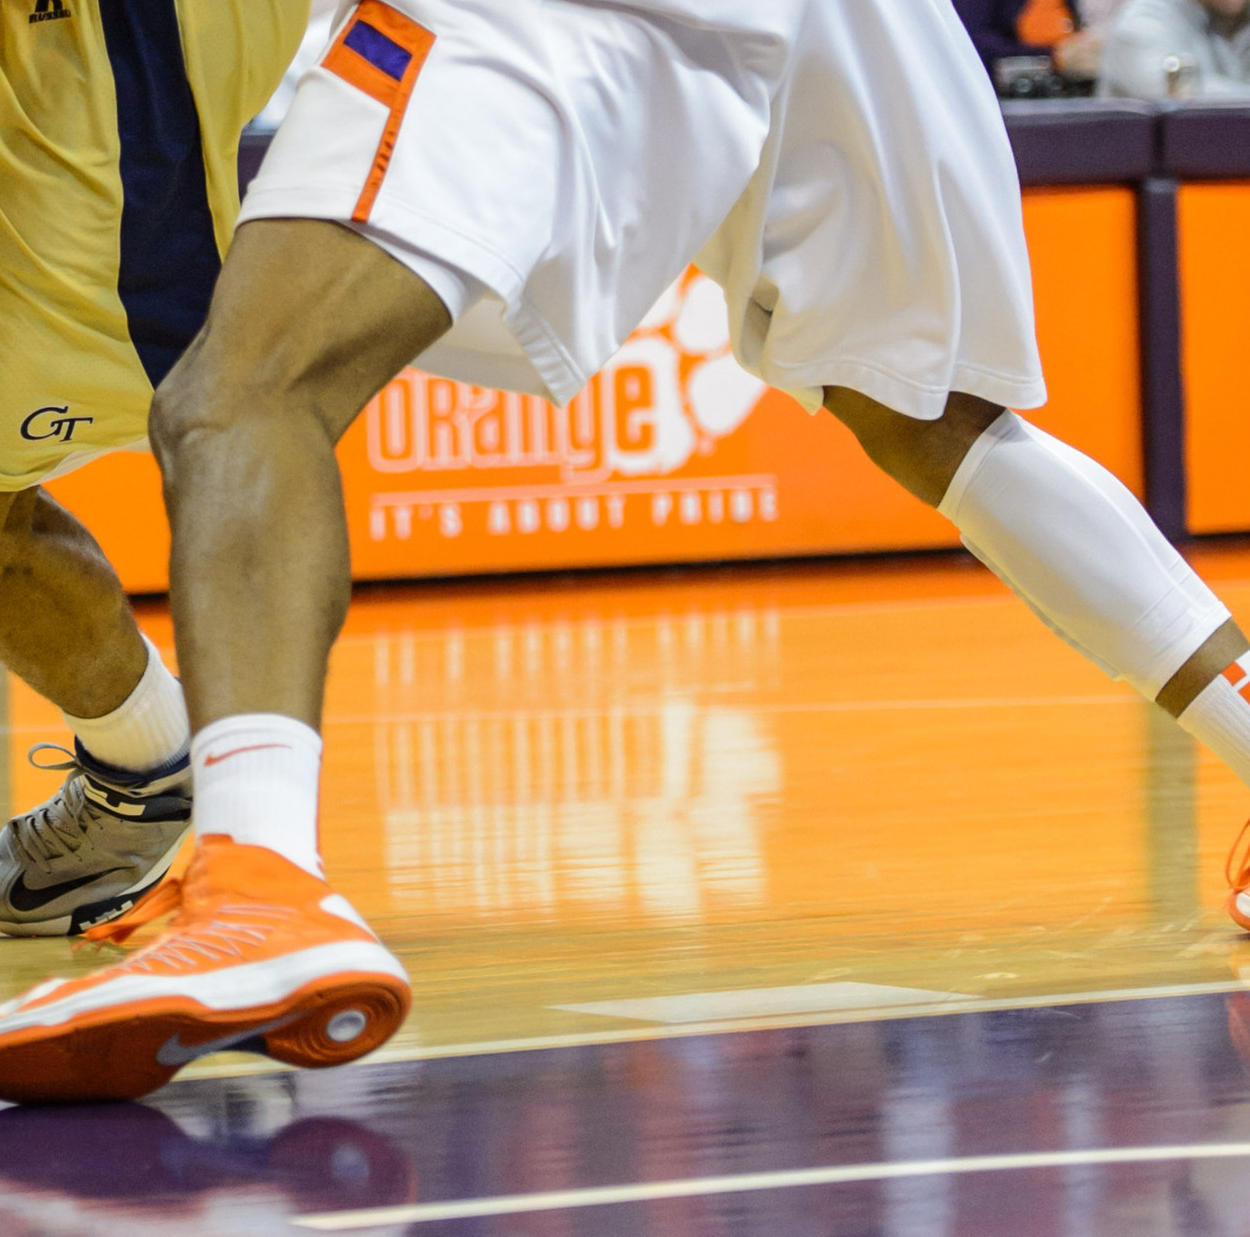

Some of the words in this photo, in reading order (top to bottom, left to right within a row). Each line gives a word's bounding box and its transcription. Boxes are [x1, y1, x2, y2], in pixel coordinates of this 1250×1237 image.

[20, 405, 94, 442] GT
[369, 504, 463, 541] IT'S
[488, 494, 627, 535] ABOUT
